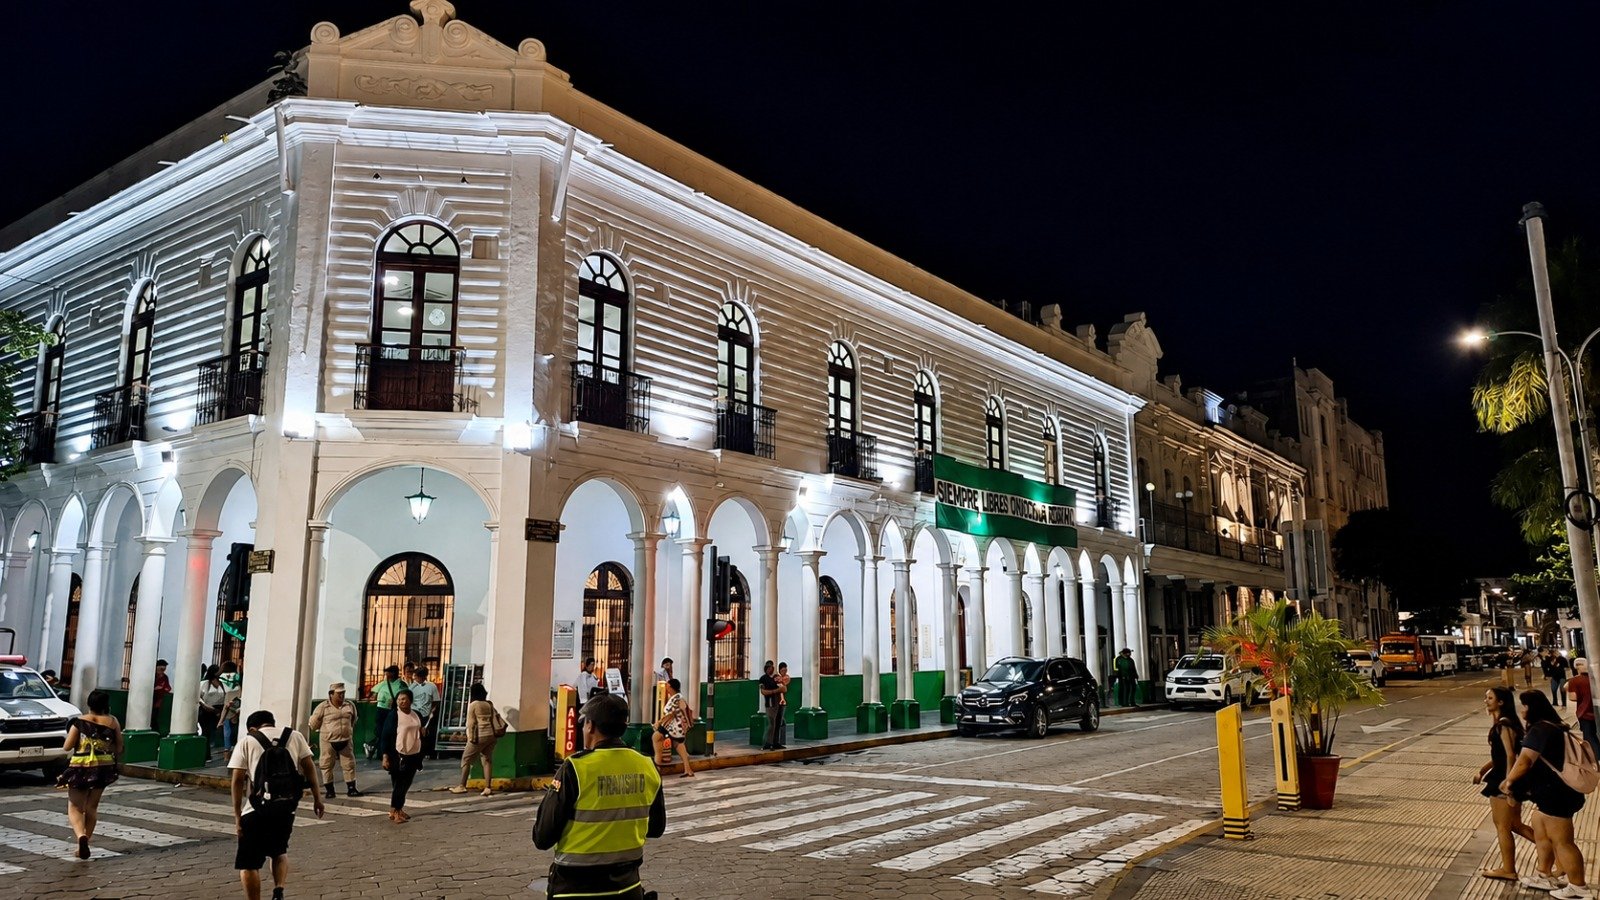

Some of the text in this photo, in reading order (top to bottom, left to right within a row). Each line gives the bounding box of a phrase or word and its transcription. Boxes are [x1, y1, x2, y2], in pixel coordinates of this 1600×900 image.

[937, 481, 979, 511] SIEMPRE
[981, 491, 1009, 514] LIBRES
[566, 707, 574, 750] ALTO
